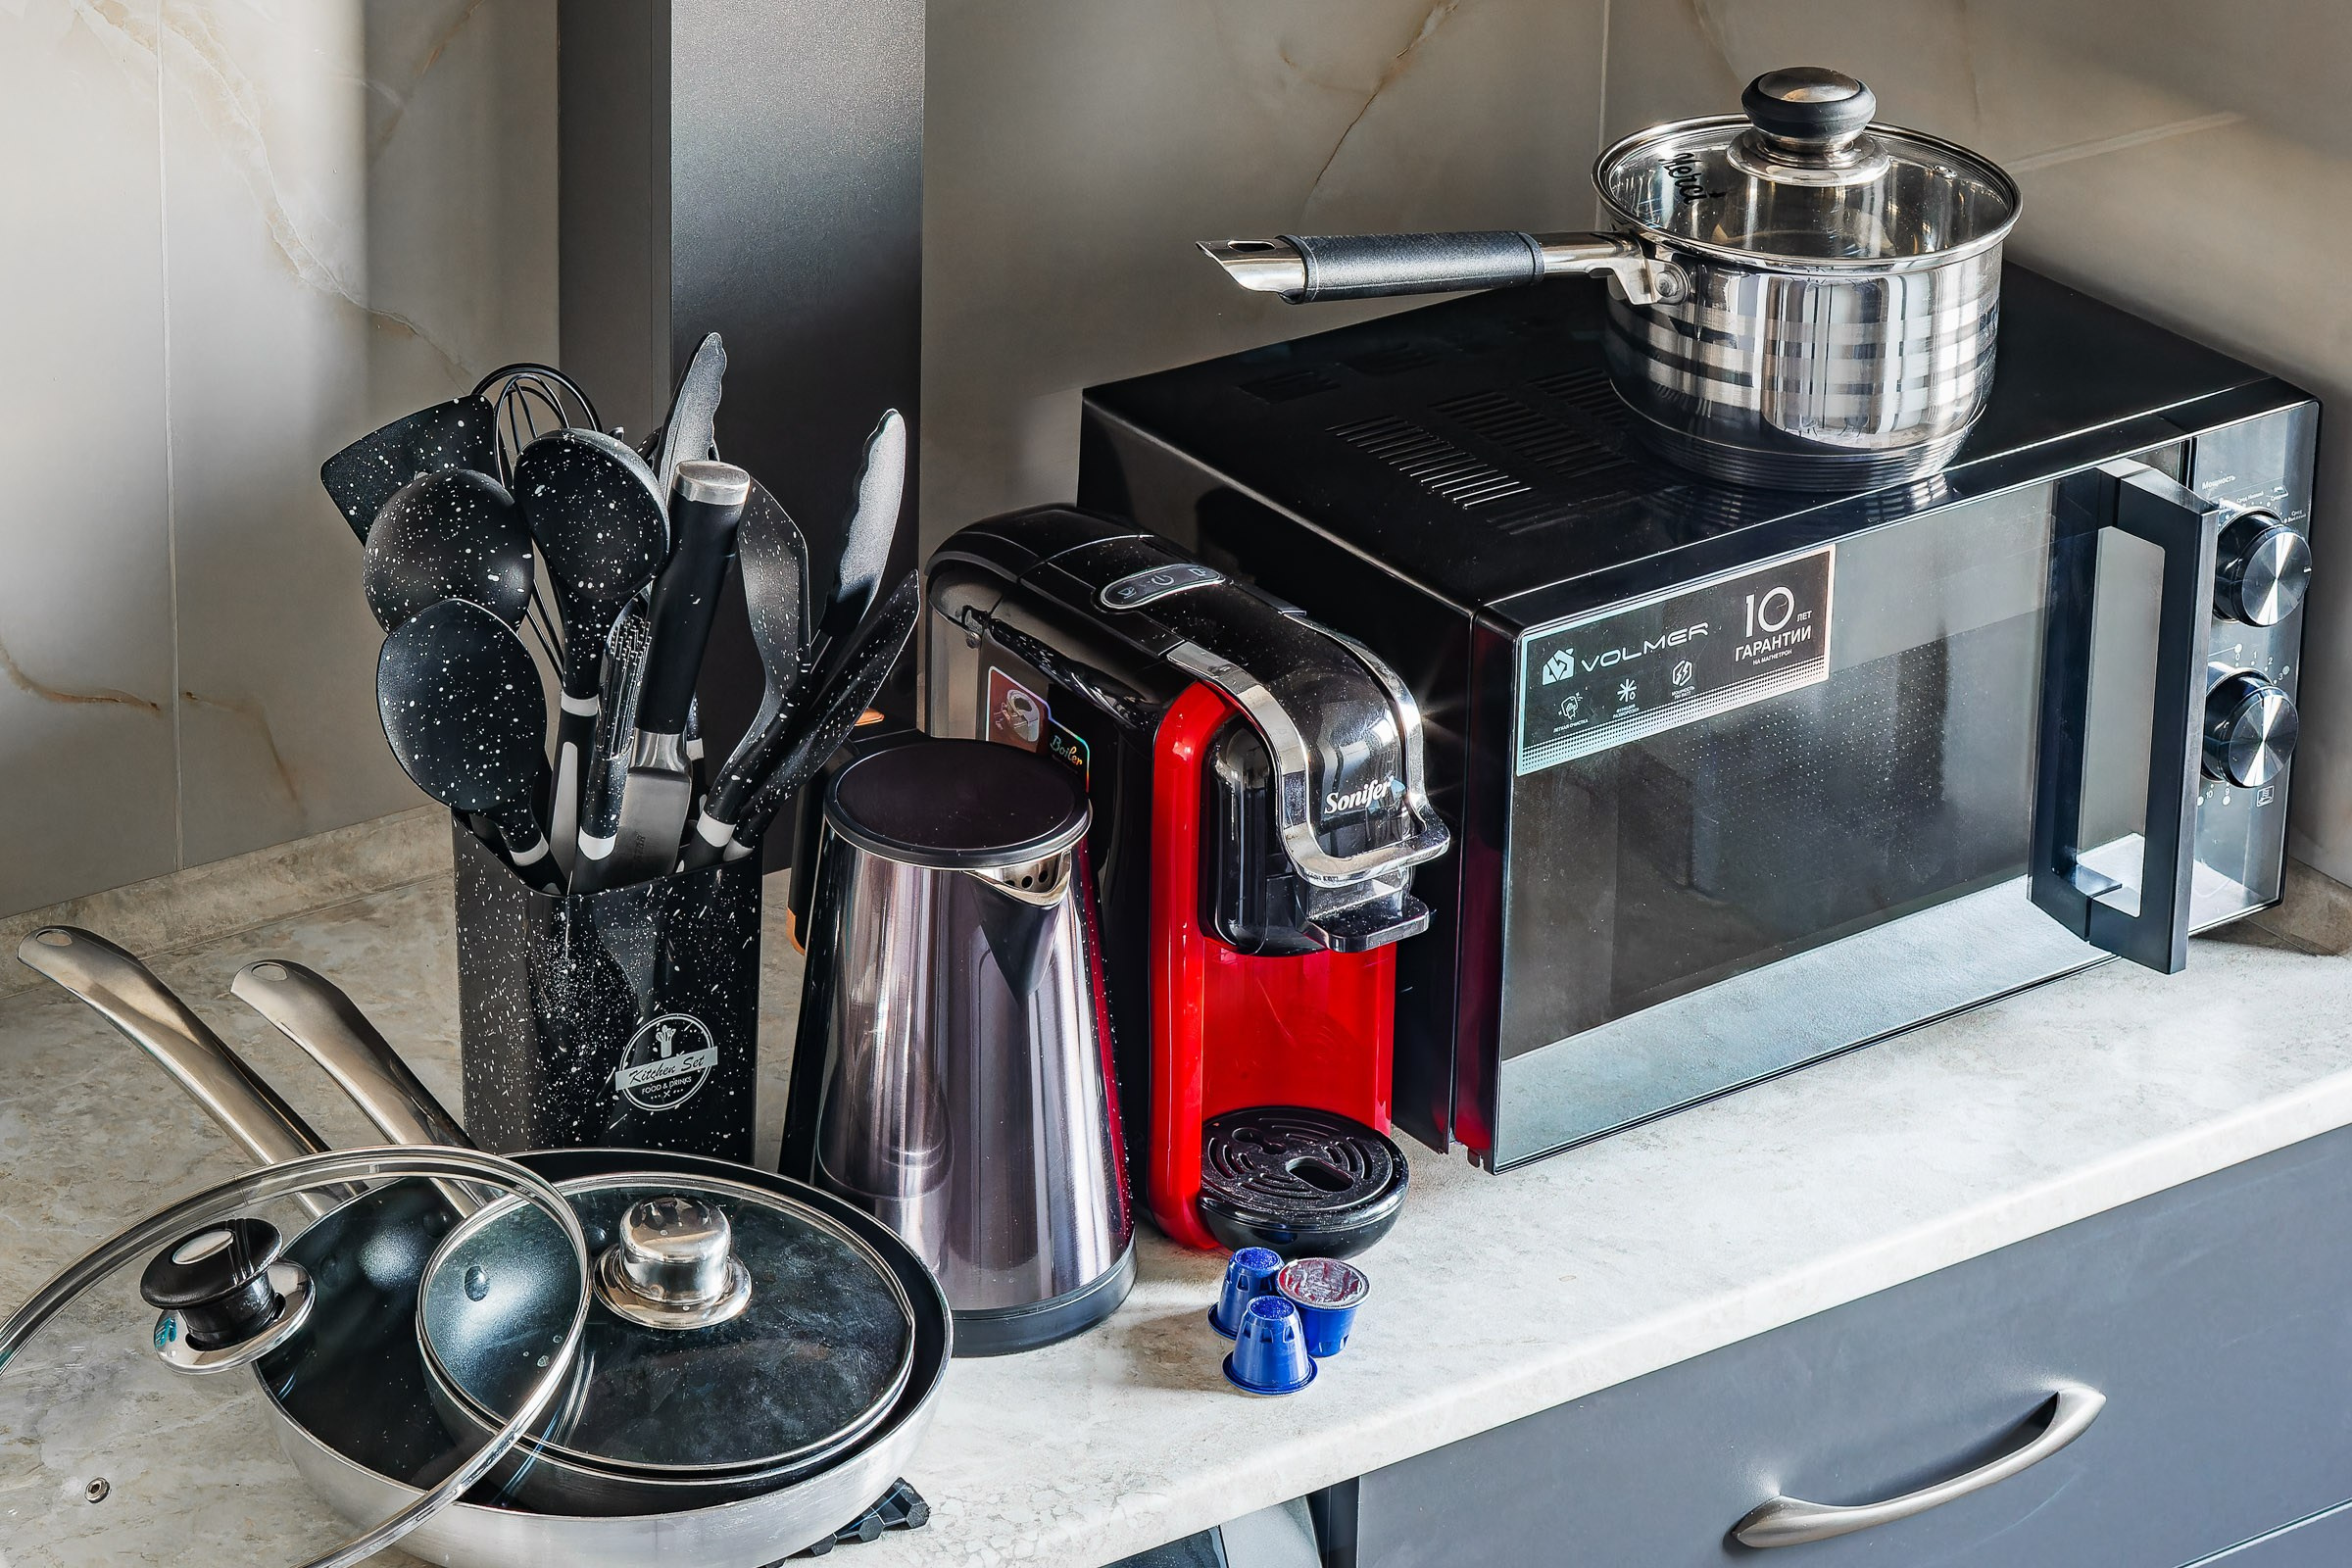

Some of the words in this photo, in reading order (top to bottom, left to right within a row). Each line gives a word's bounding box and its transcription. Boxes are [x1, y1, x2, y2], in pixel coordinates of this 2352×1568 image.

[1658, 152, 1727, 204] Merci
[1745, 586, 1794, 638] 10
[1796, 610, 1812, 622] ЛЕТ
[1581, 621, 1709, 672] VOLMER
[1735, 624, 1812, 662] ГАРАНТИИ
[1752, 657, 1761, 665] НА
[1761, 648, 1792, 663] МАГНЕТРОН
[2234, 652, 2240, 661] 0
[2253, 651, 2257, 660] 1
[2267, 657, 2274, 665] 2
[2278, 672, 2283, 681] 3
[1050, 735, 1083, 765] Boiler
[1324, 779, 1392, 814] Sonifer
[2206, 790, 2214, 800] 10
[628, 1062, 676, 1085] Kitchen
[680, 1054, 705, 1072] Set
[641, 1084, 662, 1095] FOOD
[668, 1076, 692, 1090] DRINKS
